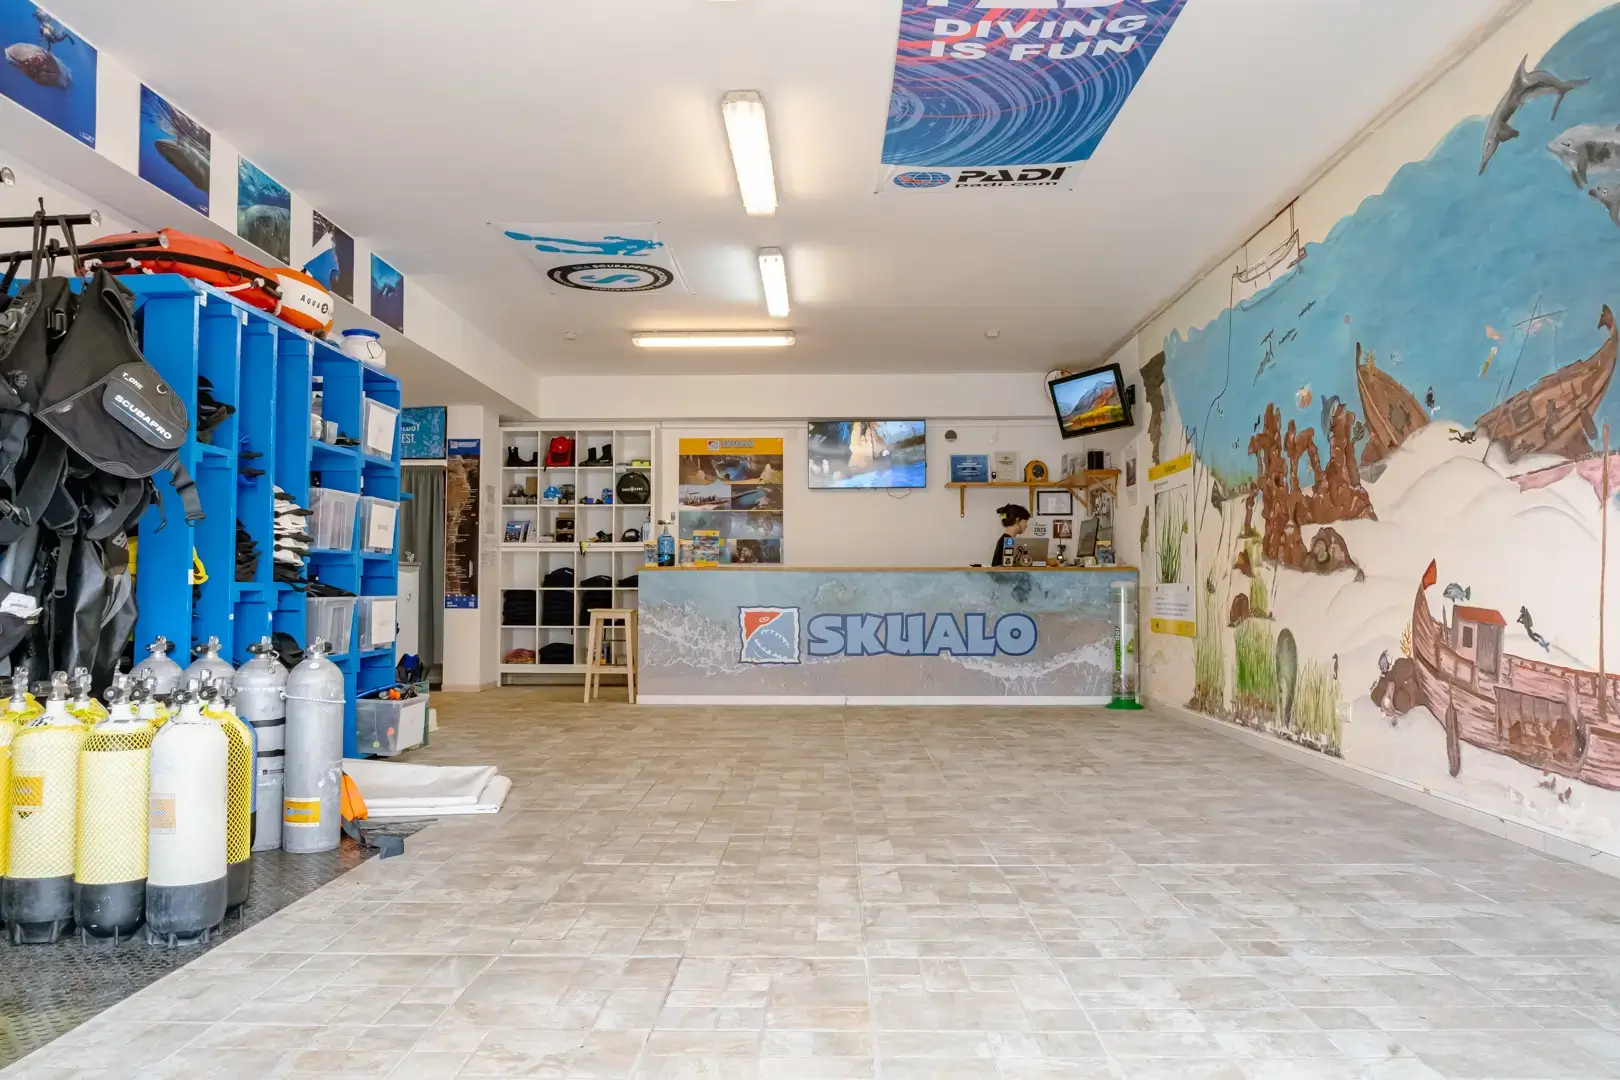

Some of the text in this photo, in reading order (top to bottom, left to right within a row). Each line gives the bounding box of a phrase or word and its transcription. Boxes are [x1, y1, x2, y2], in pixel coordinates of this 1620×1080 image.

[933, 14, 1148, 39] DIVING
[929, 35, 1138, 61] IS FUN
[957, 166, 1067, 183] PADI
[122, 371, 144, 390] T_ONE
[114, 394, 172, 440] SCUBAPRO
[807, 612, 1038, 657] SKUALO
